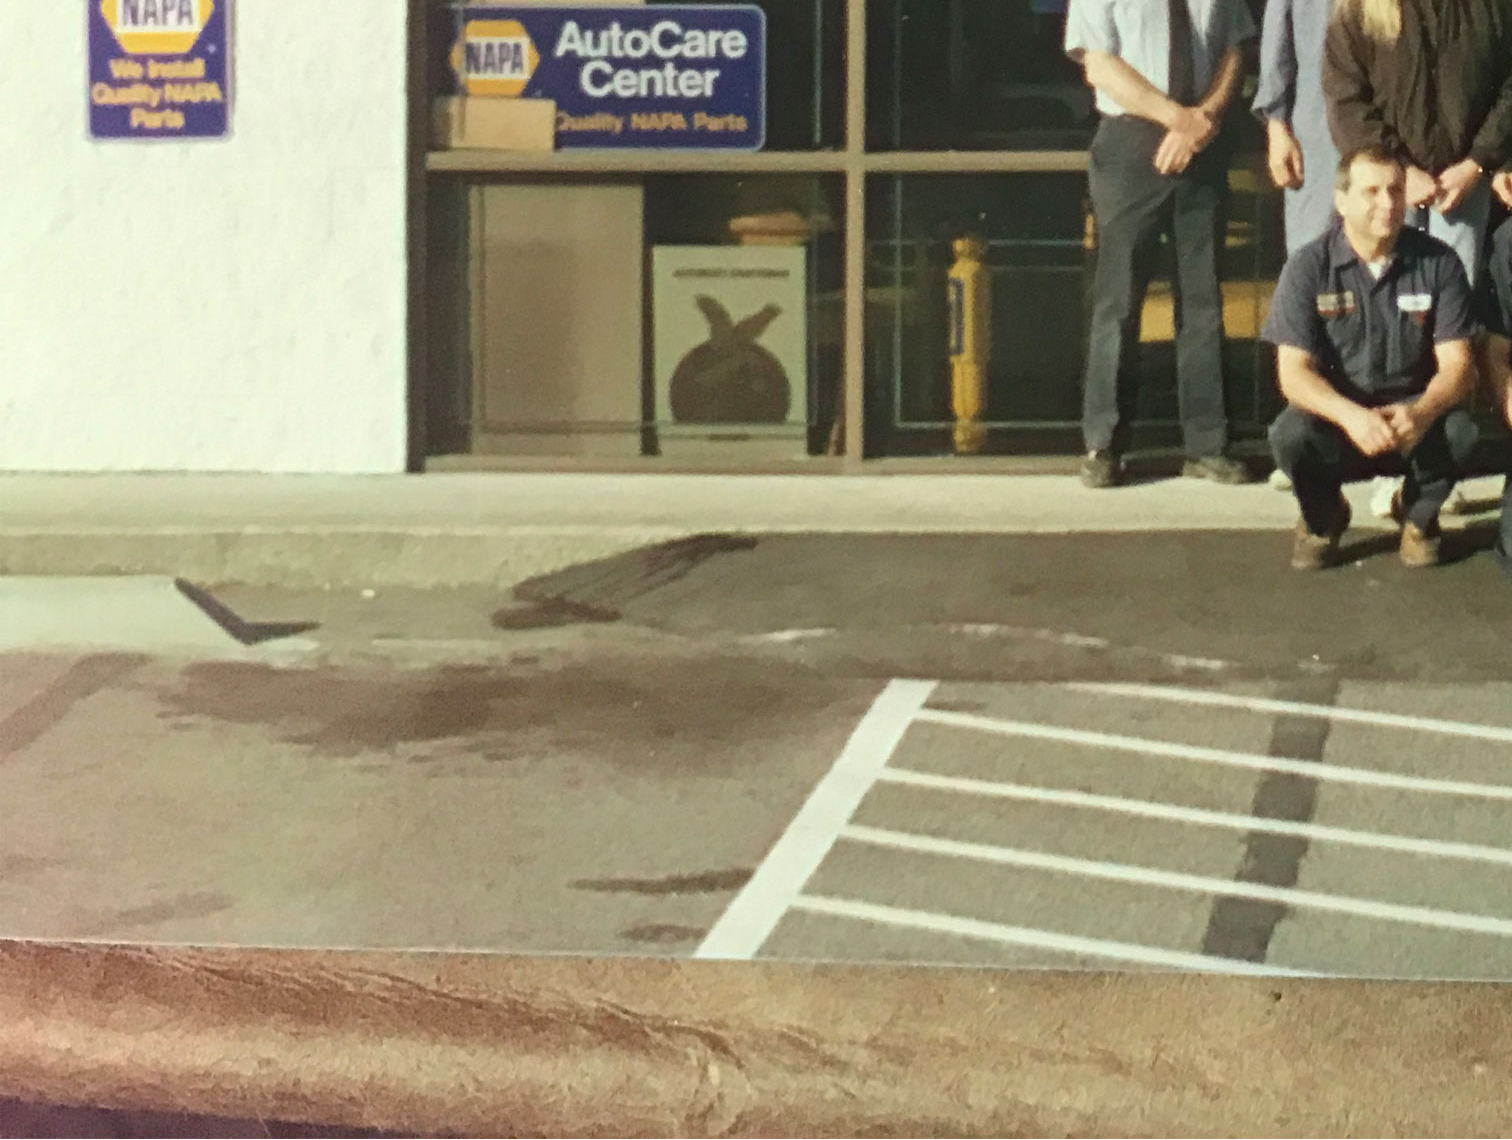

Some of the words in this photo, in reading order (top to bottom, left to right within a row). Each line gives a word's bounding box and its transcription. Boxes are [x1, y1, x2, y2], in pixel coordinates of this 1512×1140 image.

[555, 20, 749, 59] AutoCare
[463, 42, 525, 75] NAPA
[580, 60, 721, 98] Center
[130, 107, 186, 130] Parts
